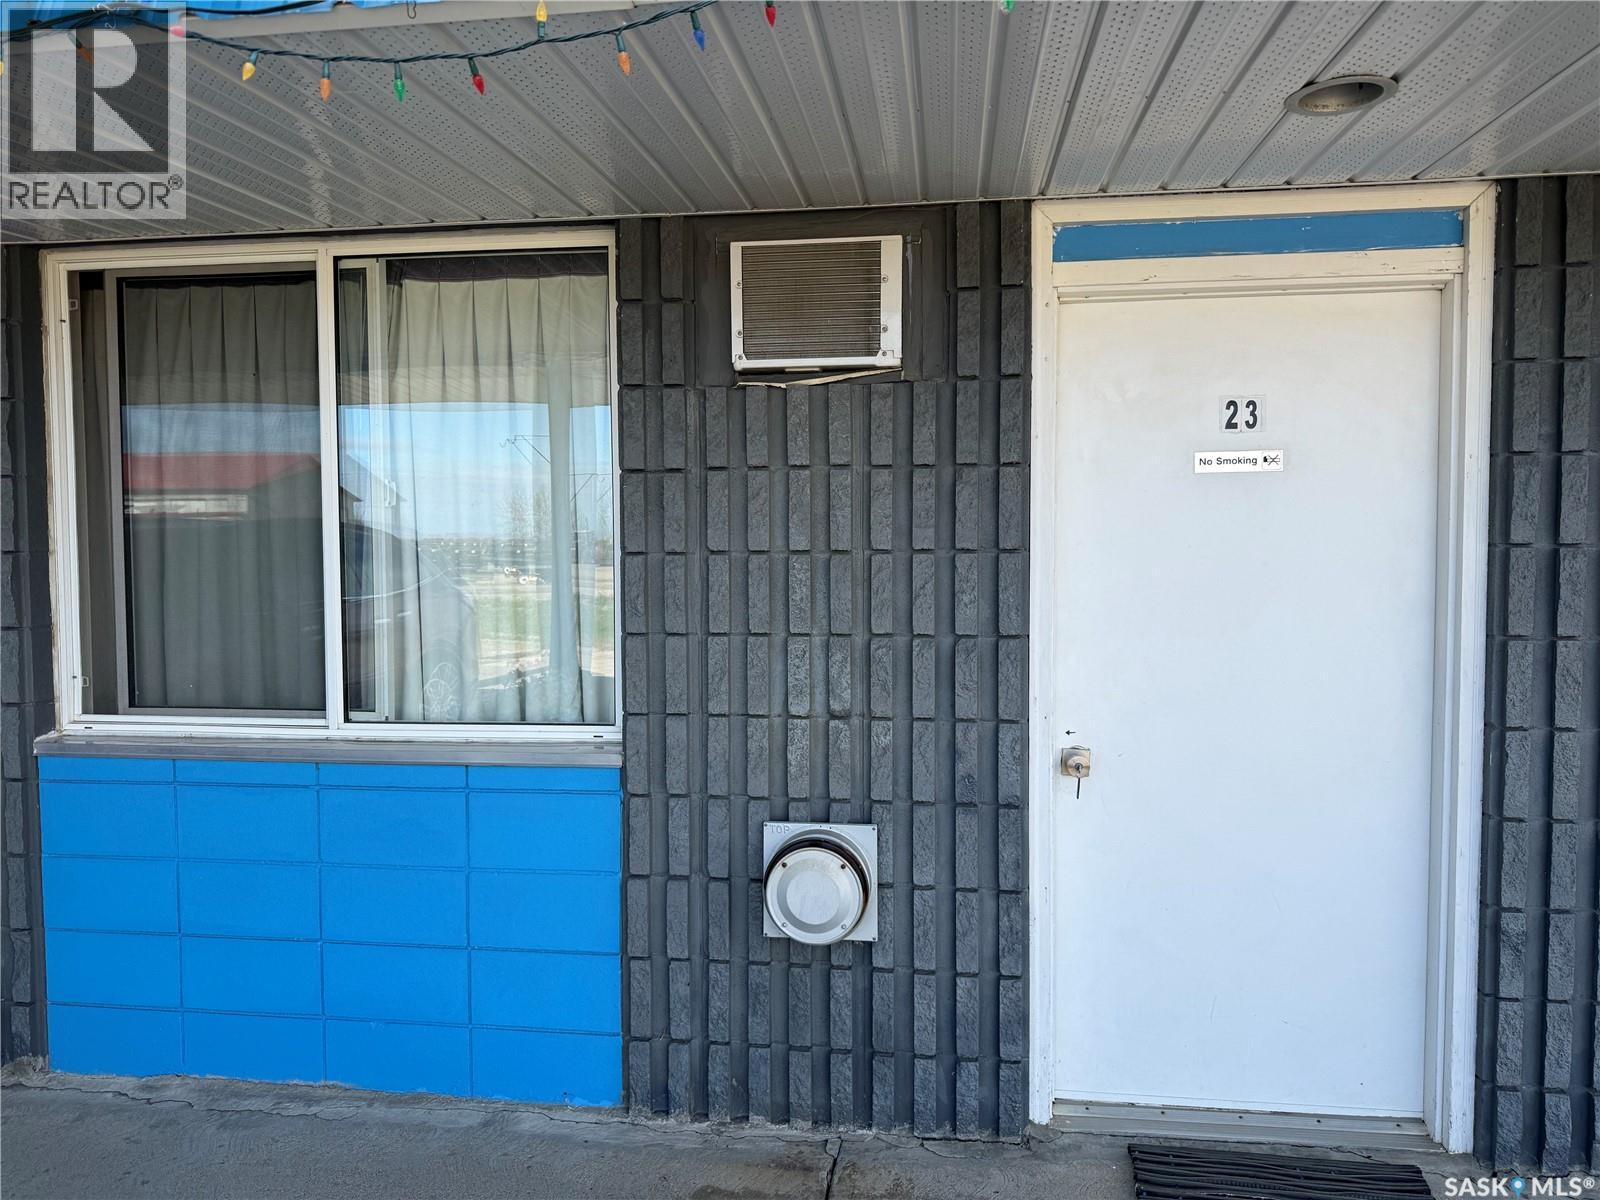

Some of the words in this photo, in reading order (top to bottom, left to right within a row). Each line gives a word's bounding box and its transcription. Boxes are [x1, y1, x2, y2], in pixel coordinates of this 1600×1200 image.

[1224, 399, 1258, 430] 23
[1199, 457, 1213, 466] No
[1216, 456, 1258, 466] Smoking
[769, 823, 790, 834] TOP
